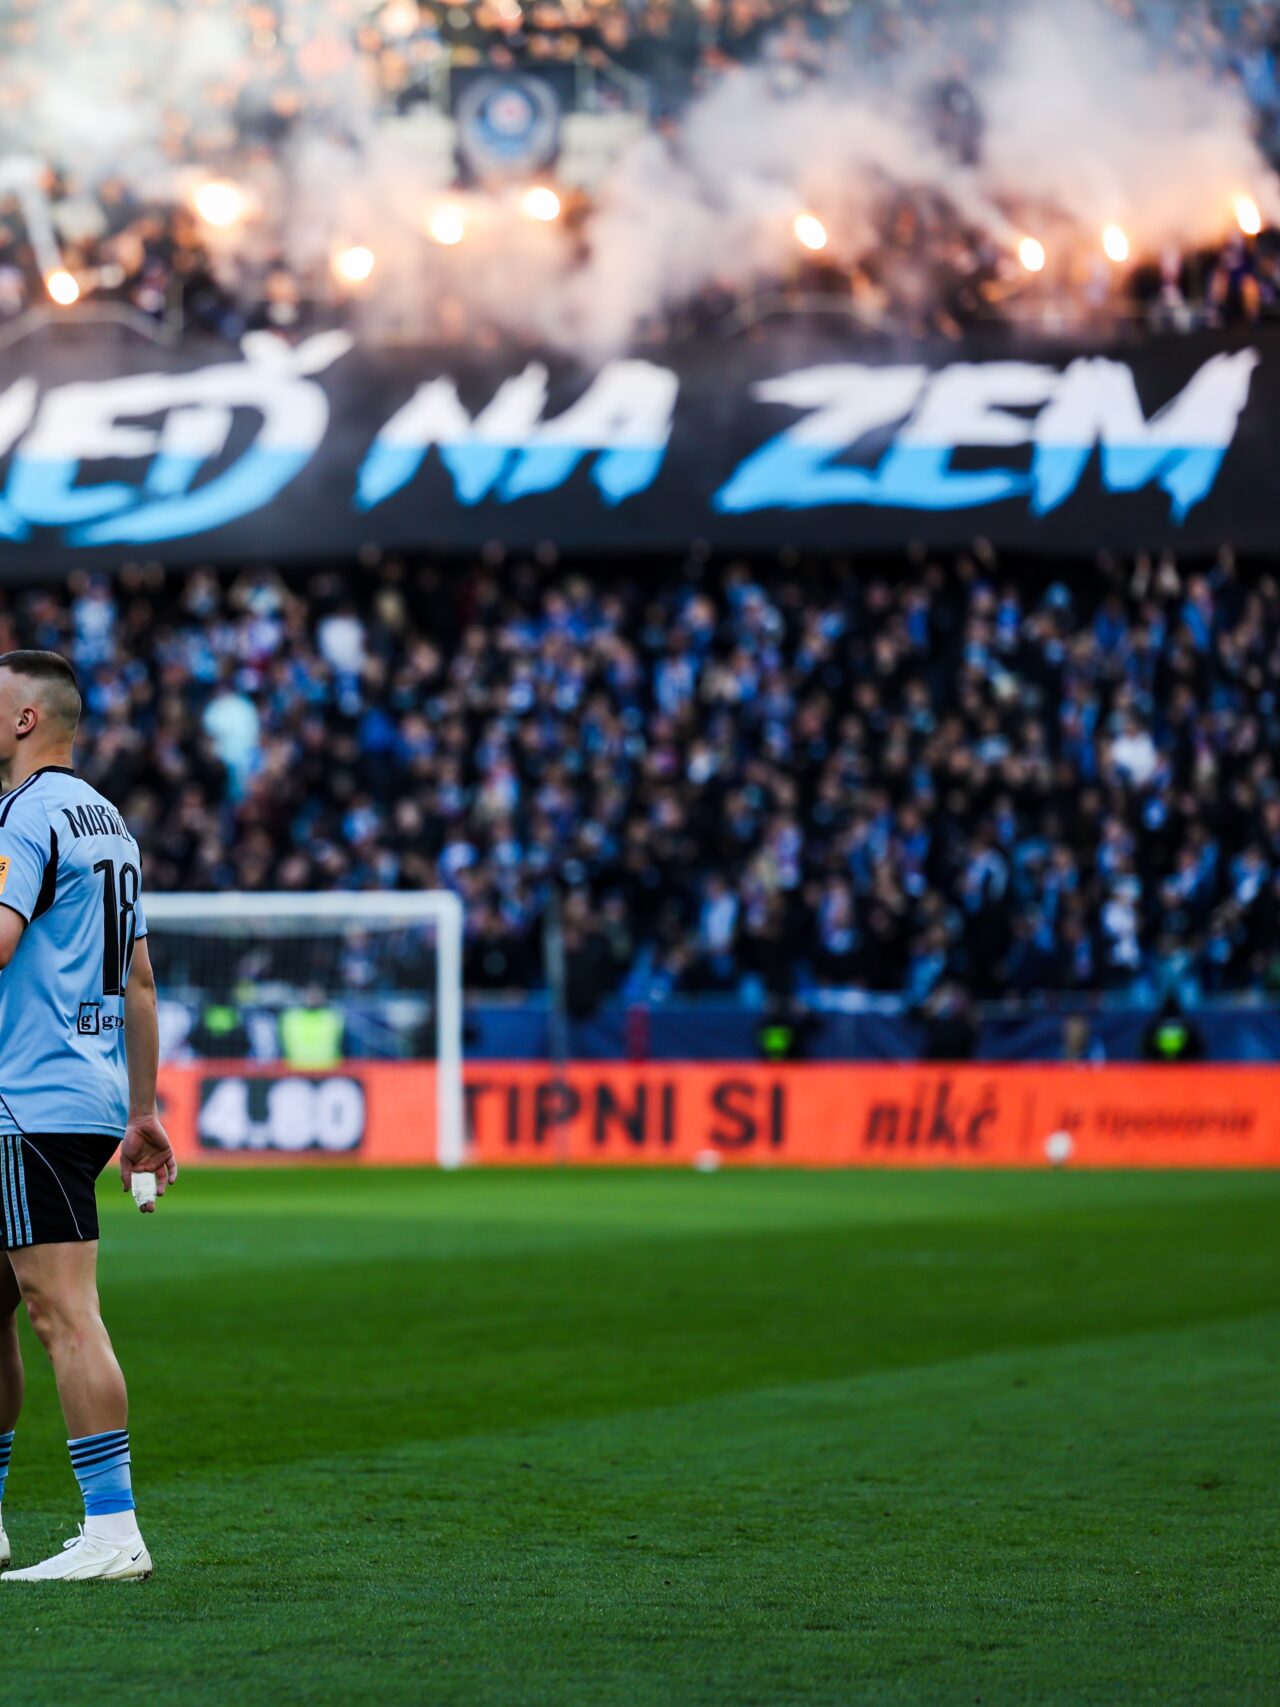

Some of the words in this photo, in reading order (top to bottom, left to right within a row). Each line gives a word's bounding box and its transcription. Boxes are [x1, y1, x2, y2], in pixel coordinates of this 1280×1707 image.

[353, 360, 680, 513] NA
[713, 347, 1260, 525] ZEM
[93, 859, 139, 997] 18
[199, 1076, 364, 1150] 4.80
[463, 1083, 673, 1145] TIPNI
[709, 1081, 783, 1147] SI
